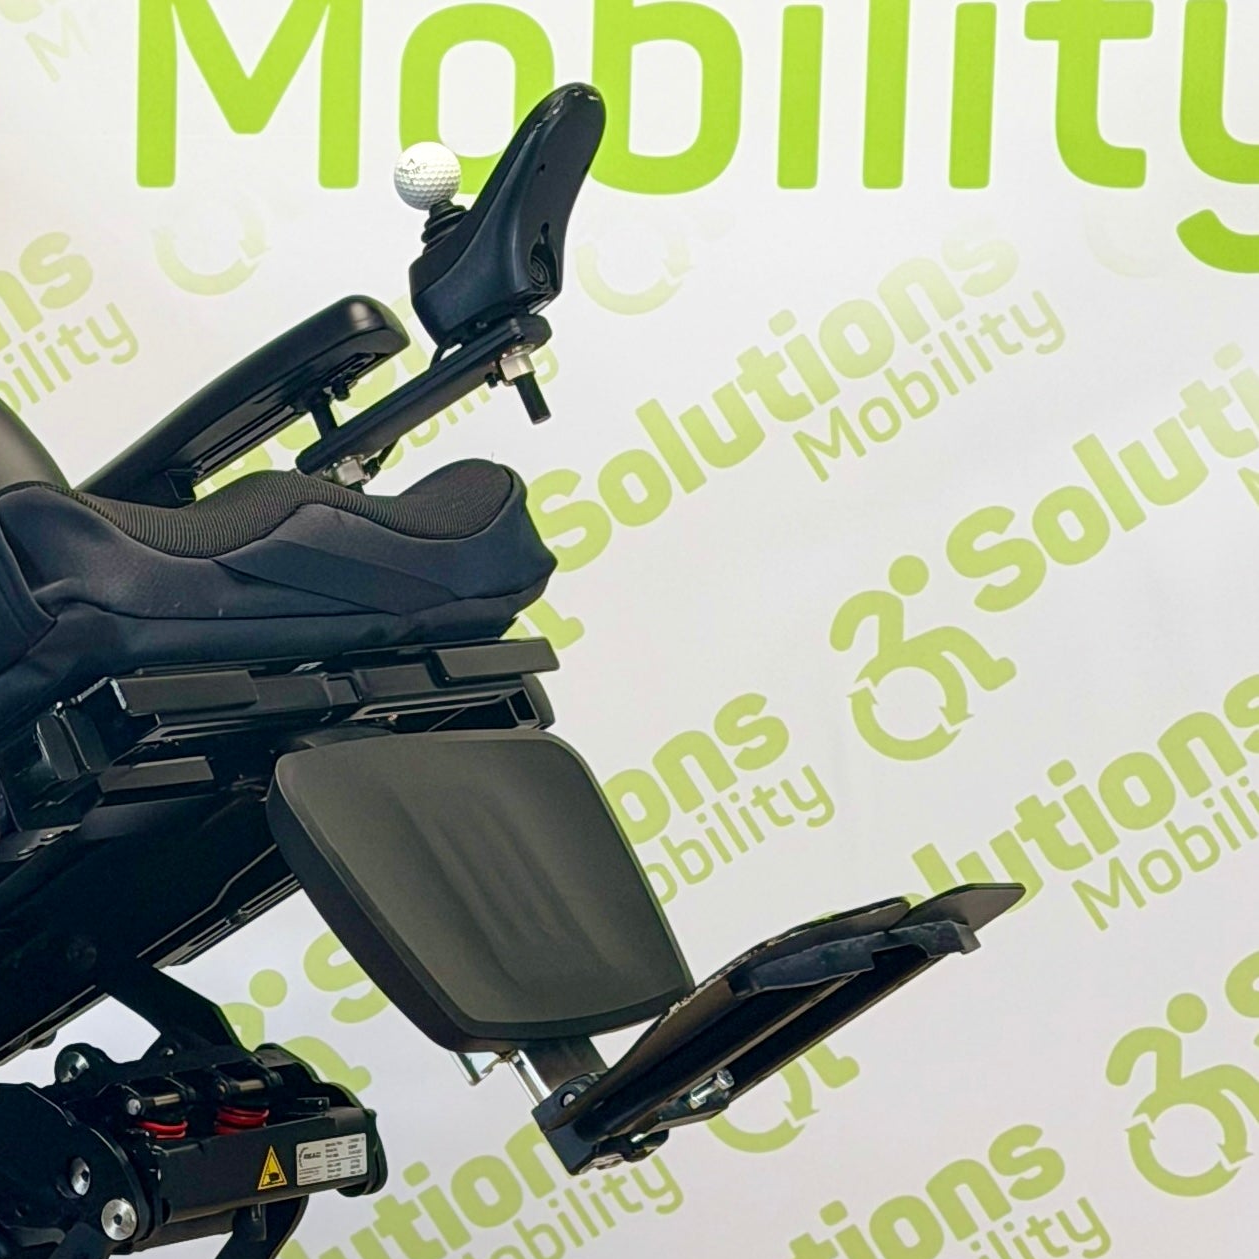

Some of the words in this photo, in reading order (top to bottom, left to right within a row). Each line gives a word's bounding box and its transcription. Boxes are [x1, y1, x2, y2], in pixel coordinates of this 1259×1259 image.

[528, 232, 1020, 573] Solutions
[793, 290, 1066, 482] Mobility
[946, 342, 1259, 612] Soluti
